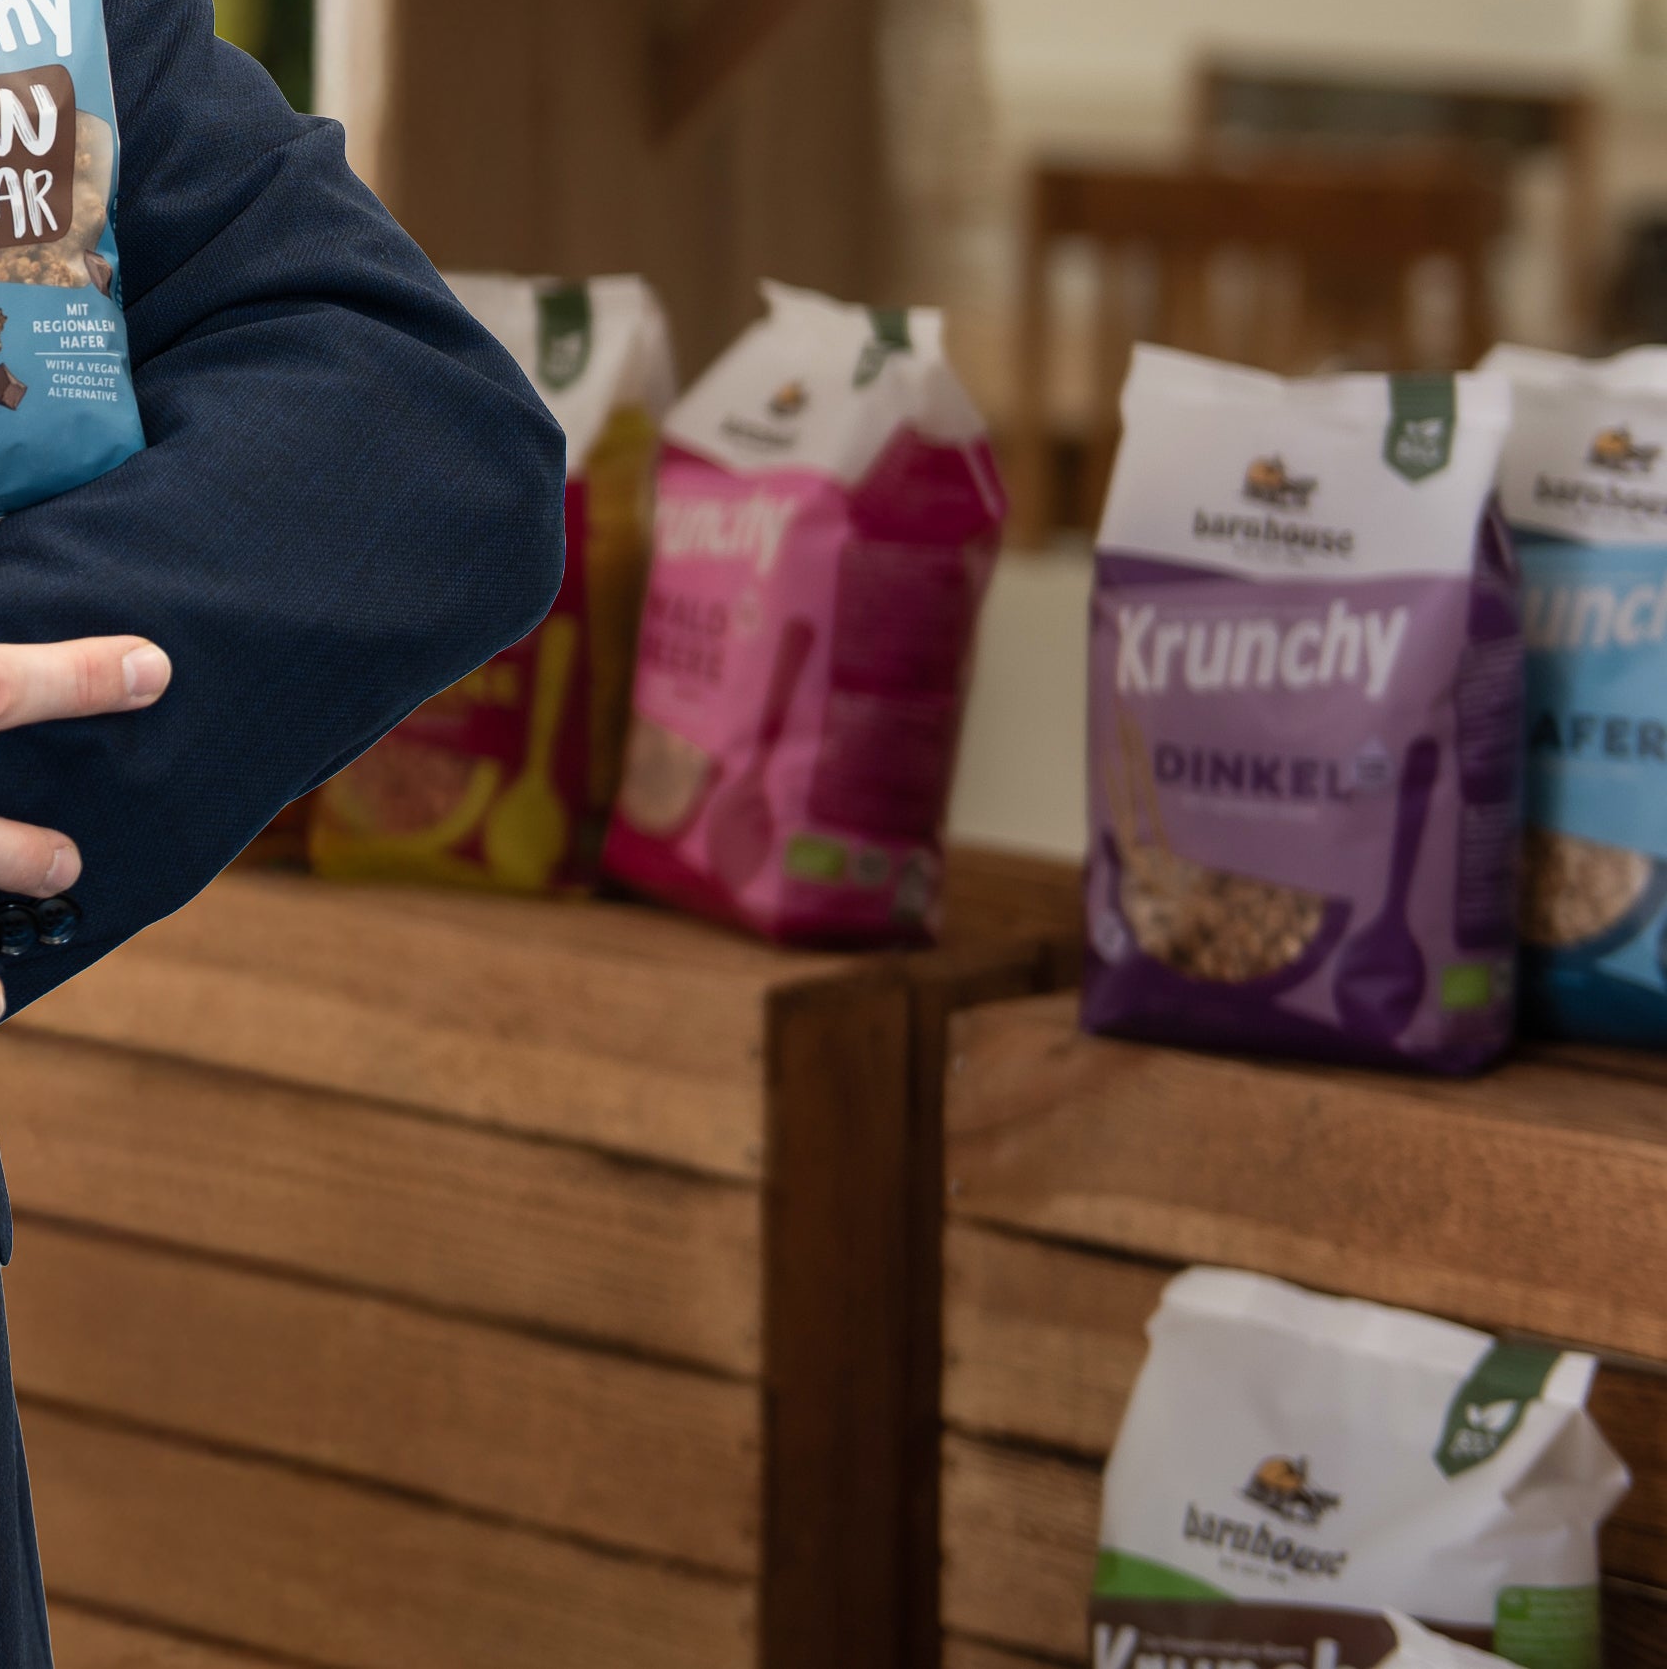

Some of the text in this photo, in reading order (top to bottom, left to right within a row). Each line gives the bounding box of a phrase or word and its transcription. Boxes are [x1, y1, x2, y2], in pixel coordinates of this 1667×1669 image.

[66, 303, 88, 316] MIT
[32, 319, 116, 334] REGIONALEM
[60, 335, 105, 349] HAFER
[45, 359, 120, 375] WITH A VEGAN
[52, 373, 116, 388] CHOCOLATE
[47, 387, 118, 402] ALTERNATIVE
[1534, 474, 1667, 516] barnhou
[1192, 511, 1353, 555] barnhouse
[1116, 599, 1409, 702] Krunchy
[1533, 714, 1667, 761] AFER
[1154, 741, 1355, 805] DINKEL
[1182, 1503, 1348, 1579] barnhouse
